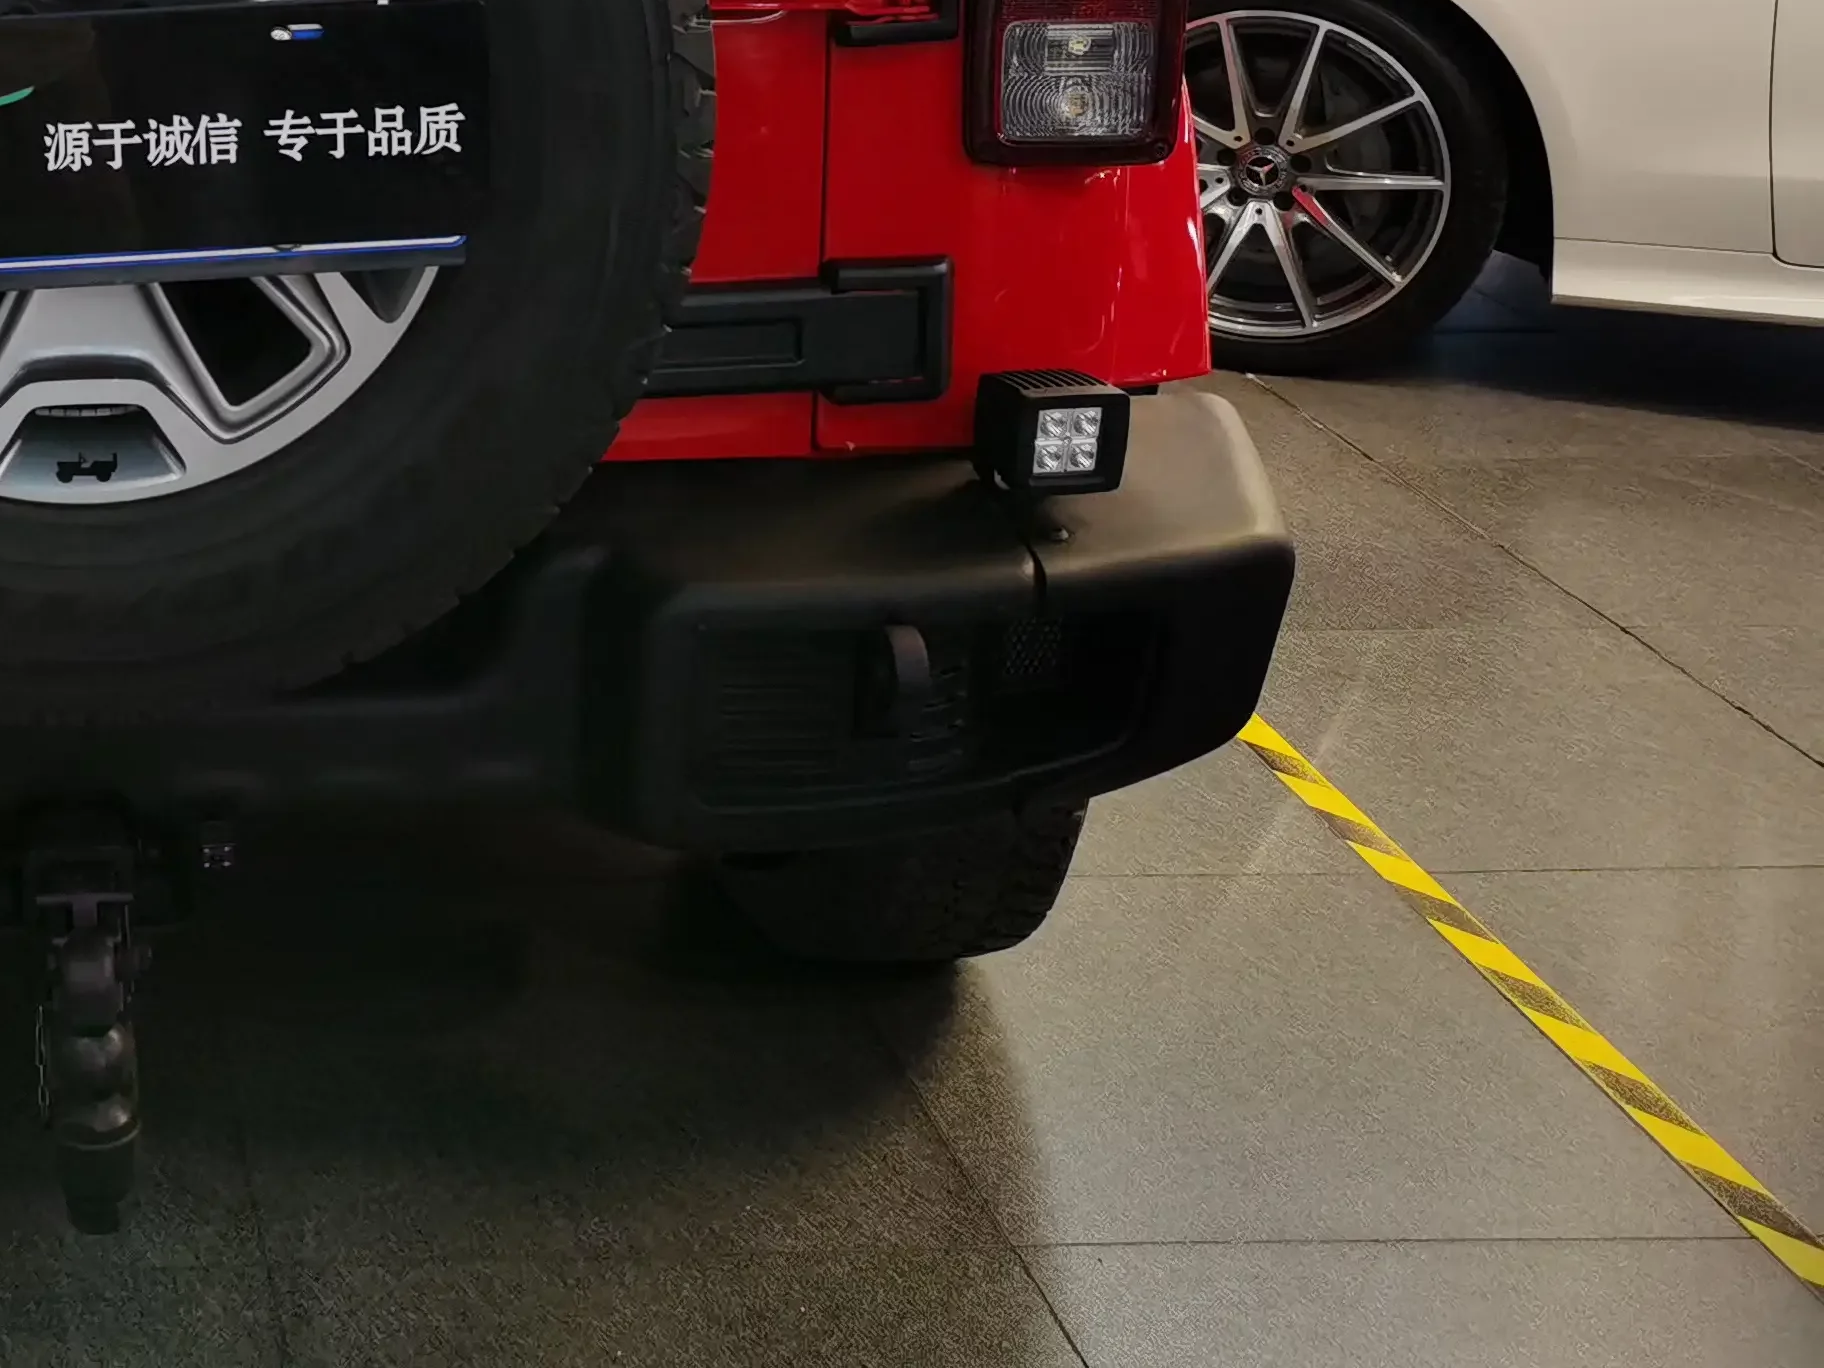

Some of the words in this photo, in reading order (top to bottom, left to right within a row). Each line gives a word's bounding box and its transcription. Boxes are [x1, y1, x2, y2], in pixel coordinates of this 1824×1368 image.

[43, 113, 243, 172] 源于诚信
[263, 102, 466, 162] 专于品质
